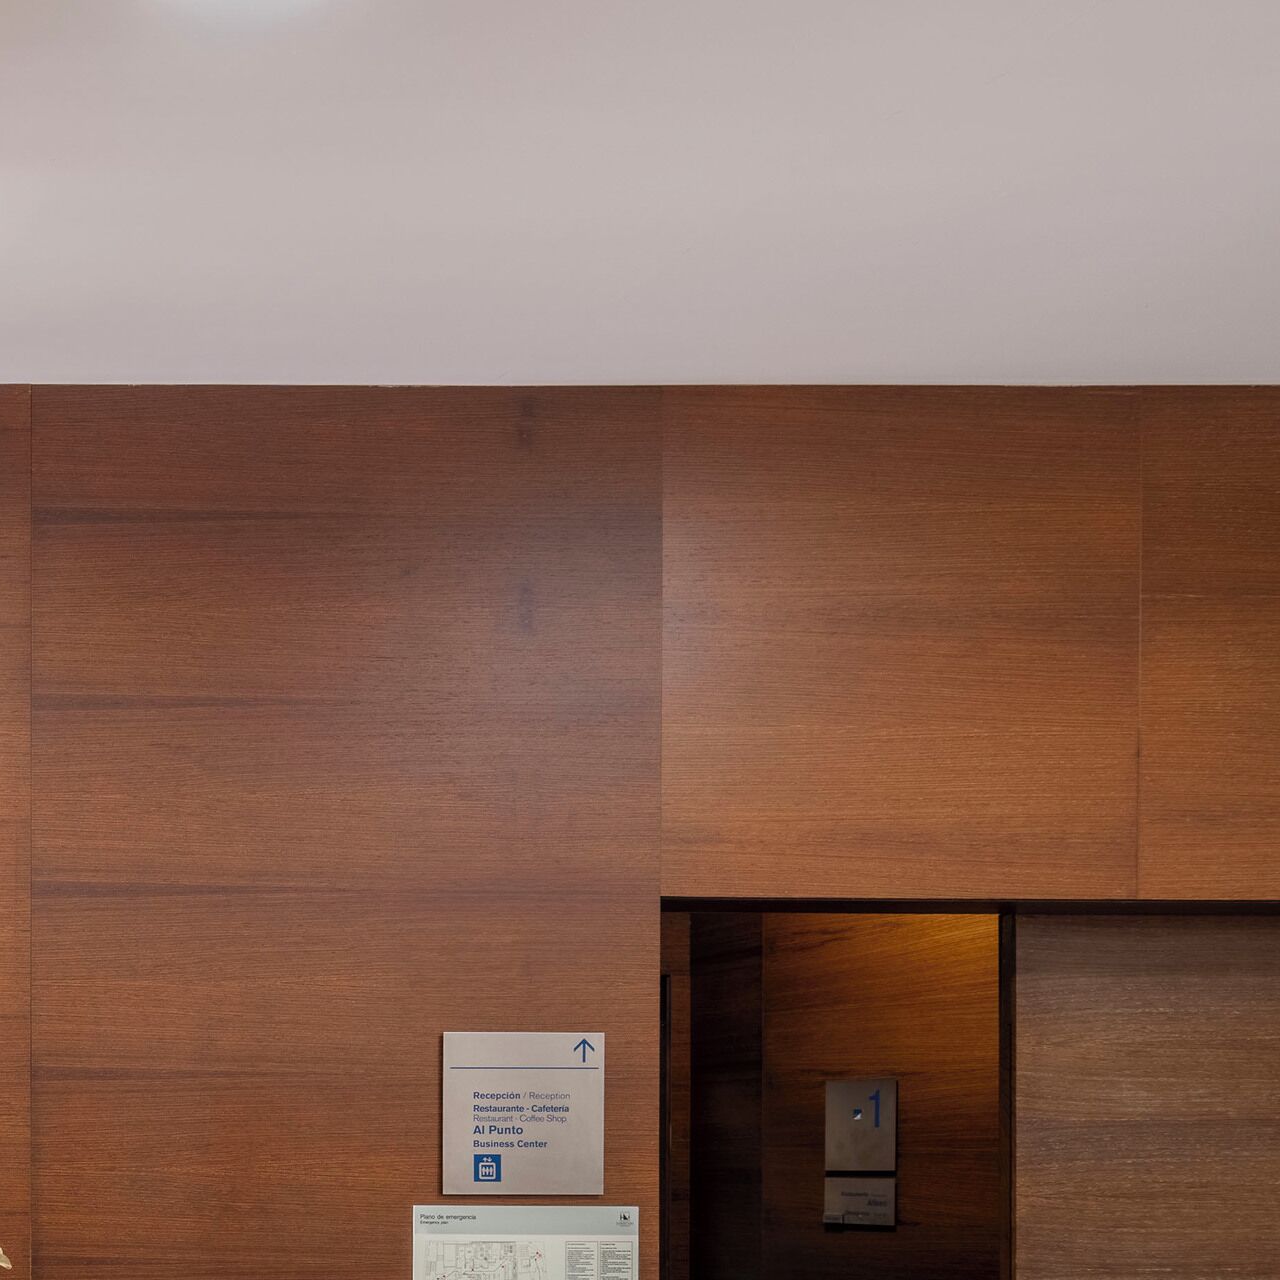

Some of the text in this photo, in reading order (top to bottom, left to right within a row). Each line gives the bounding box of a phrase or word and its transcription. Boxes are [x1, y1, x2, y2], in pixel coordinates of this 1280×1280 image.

[473, 1091, 521, 1101] Recepción
[529, 1092, 570, 1101] Reception
[531, 1104, 569, 1112] Cafetería
[869, 1089, 880, 1128] 1
[546, 1115, 567, 1124] Shop
[473, 1125, 523, 1134] Al Punto
